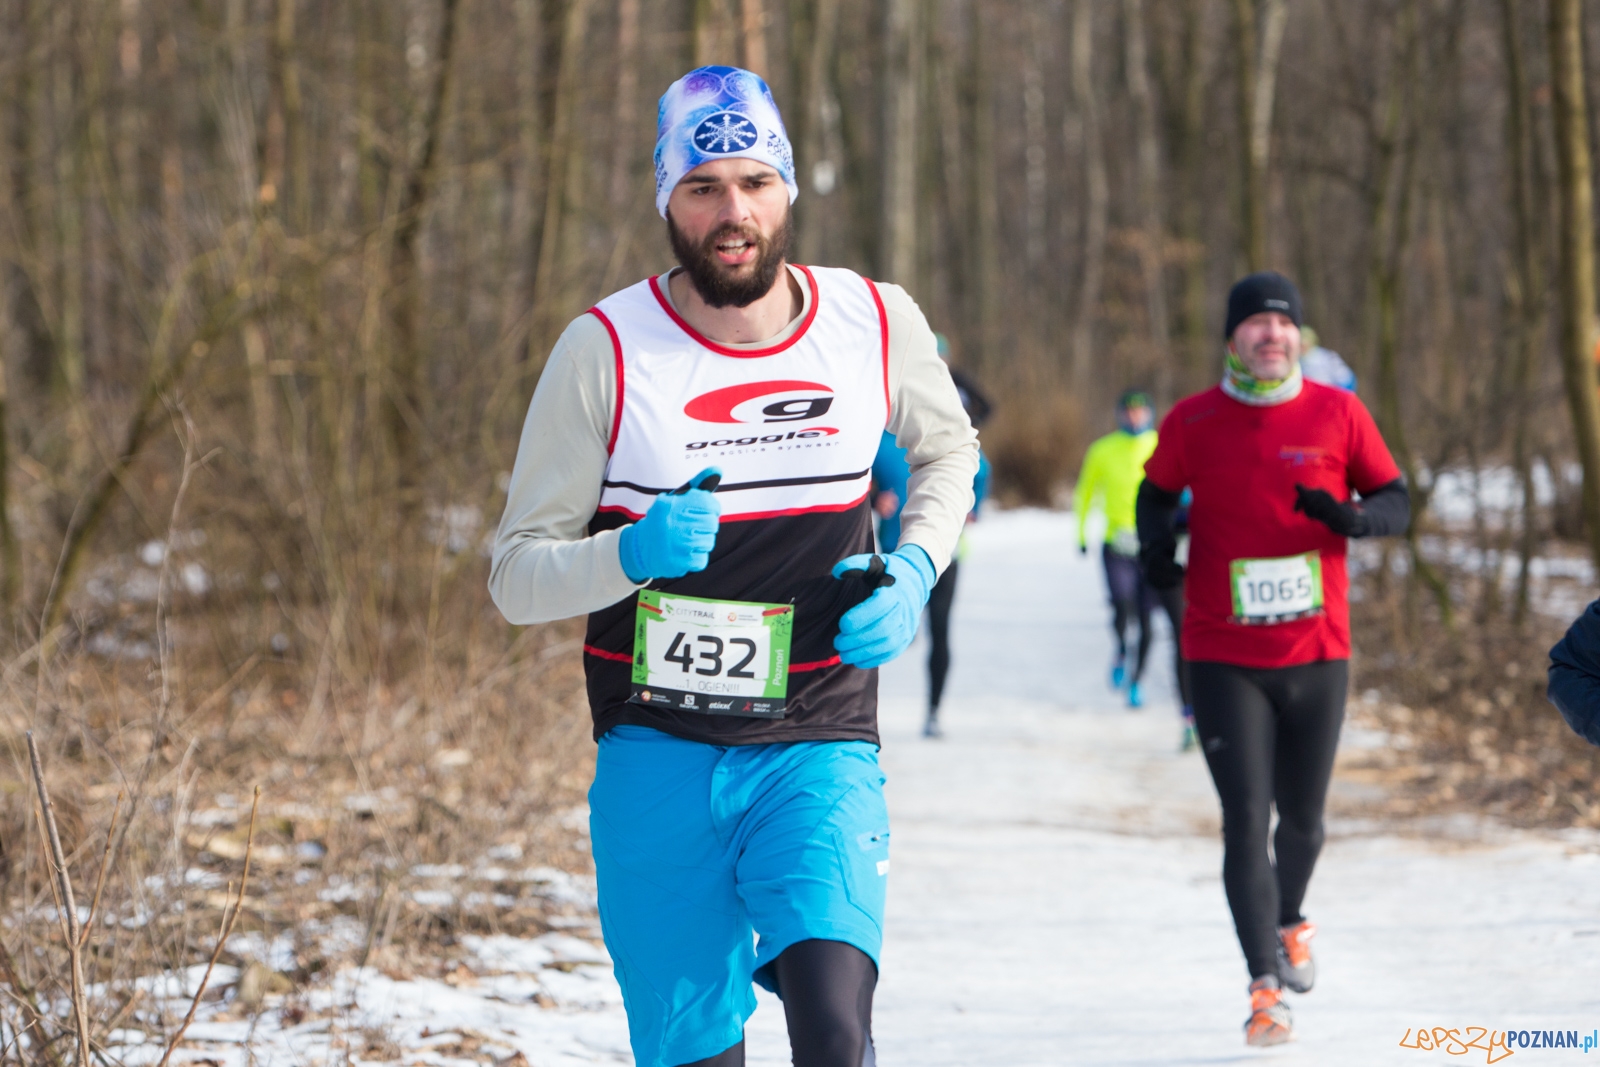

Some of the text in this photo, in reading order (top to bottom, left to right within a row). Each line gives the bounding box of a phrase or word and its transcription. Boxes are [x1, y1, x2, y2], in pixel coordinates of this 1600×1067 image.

[685, 431, 821, 451] goggle
[1246, 575, 1312, 604] 1065
[663, 632, 757, 679] 432
